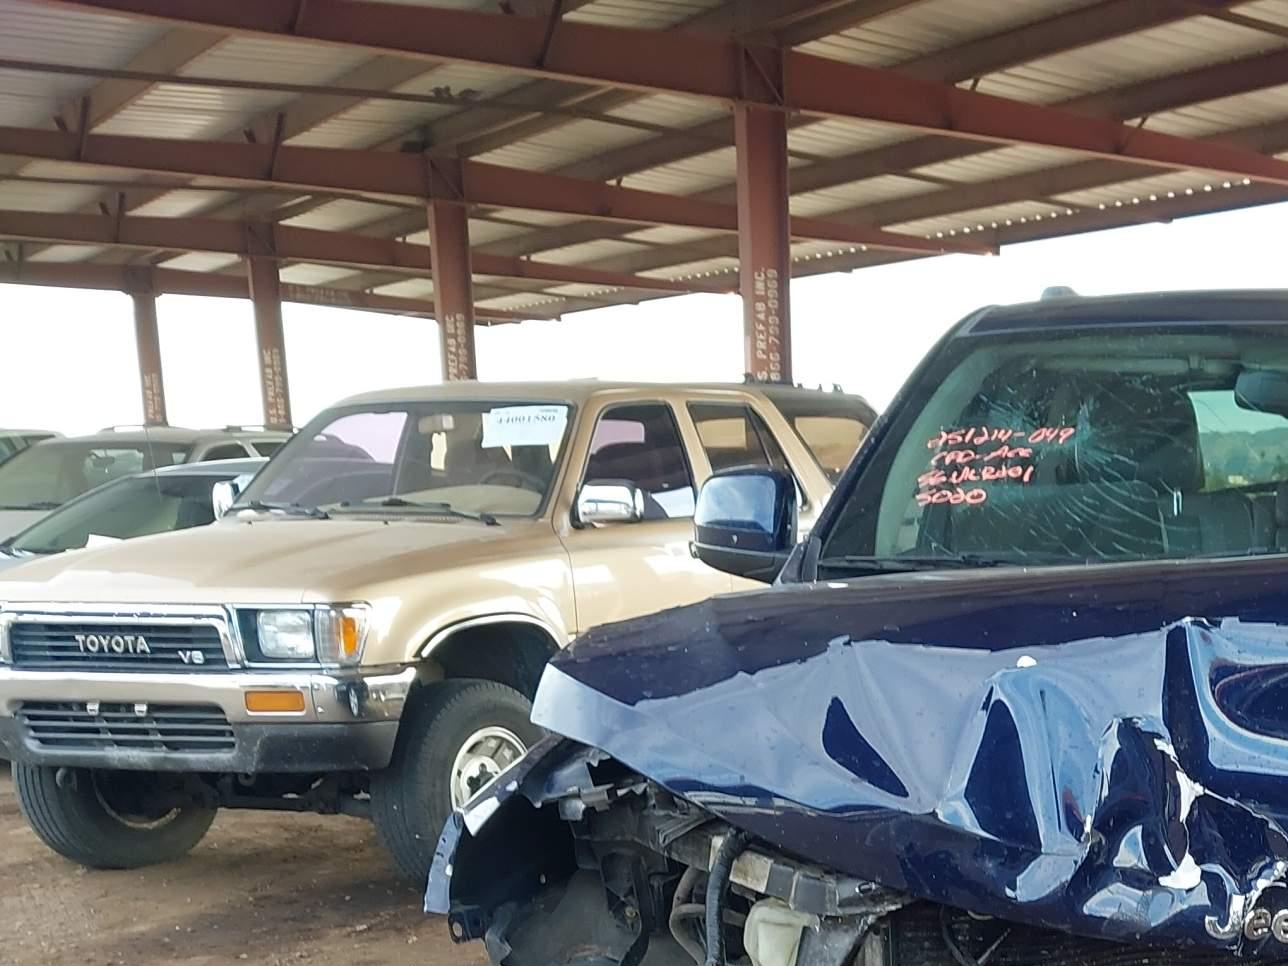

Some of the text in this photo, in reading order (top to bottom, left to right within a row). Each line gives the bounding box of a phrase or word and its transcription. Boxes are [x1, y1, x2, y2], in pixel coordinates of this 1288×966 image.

[755, 302, 767, 359] PREFAB
[74, 634, 151, 655] TOYOTA
[177, 650, 205, 665] V6
